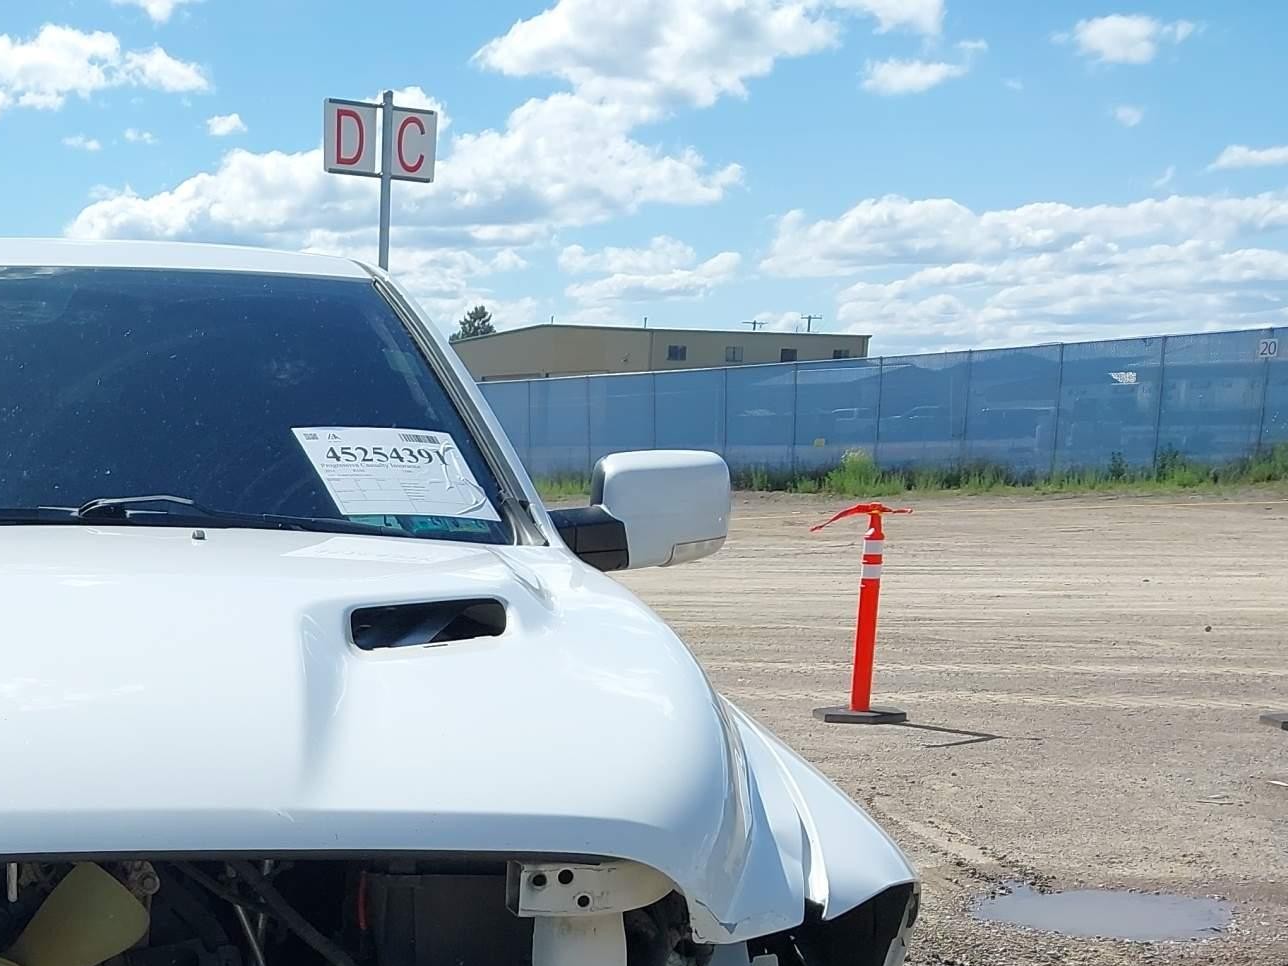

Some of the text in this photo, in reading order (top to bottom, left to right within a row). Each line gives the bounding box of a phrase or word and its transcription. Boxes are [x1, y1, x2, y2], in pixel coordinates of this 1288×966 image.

[336, 108, 364, 165] D
[397, 116, 425, 173] C
[1260, 341, 1277, 355] 20
